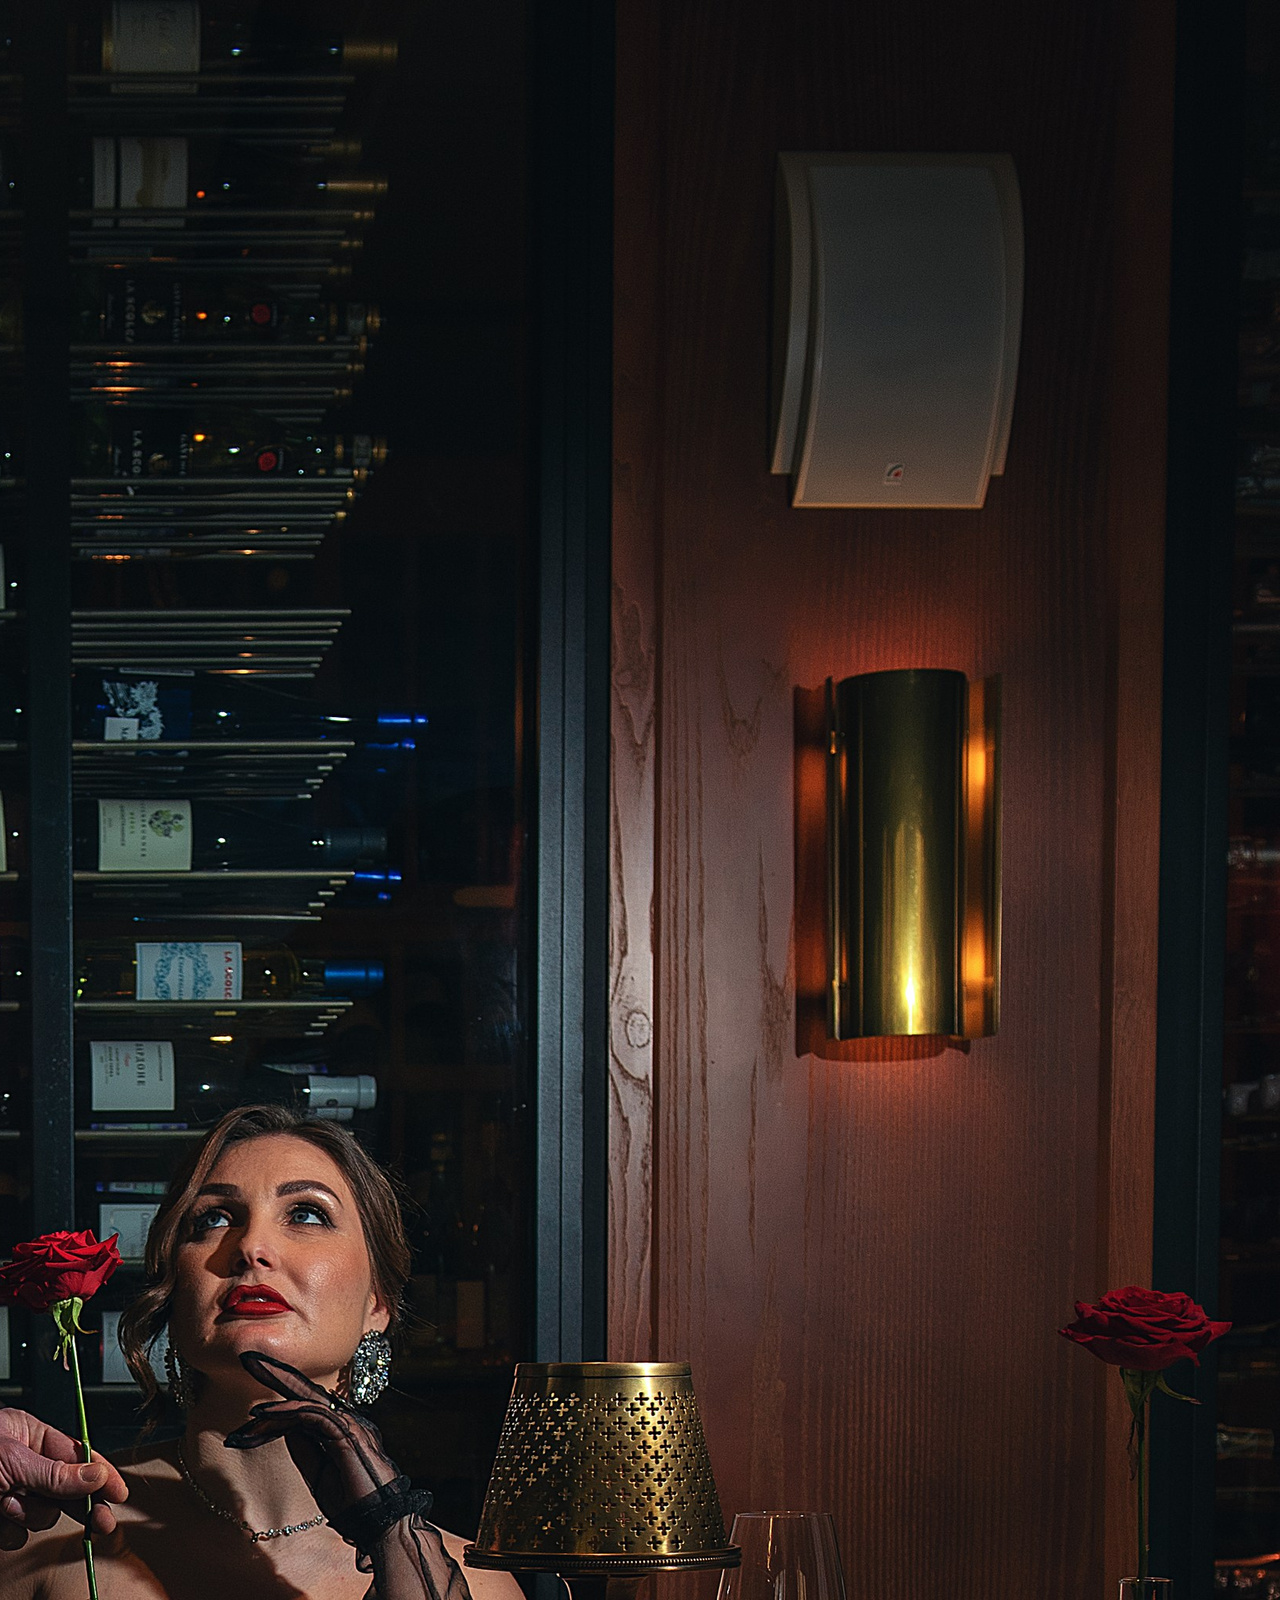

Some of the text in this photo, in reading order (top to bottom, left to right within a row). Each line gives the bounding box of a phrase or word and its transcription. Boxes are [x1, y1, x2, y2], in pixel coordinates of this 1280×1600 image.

[125, 280, 136, 344] LA SCOLCA
[132, 430, 143, 447] LA
[224, 951, 232, 963] LA
